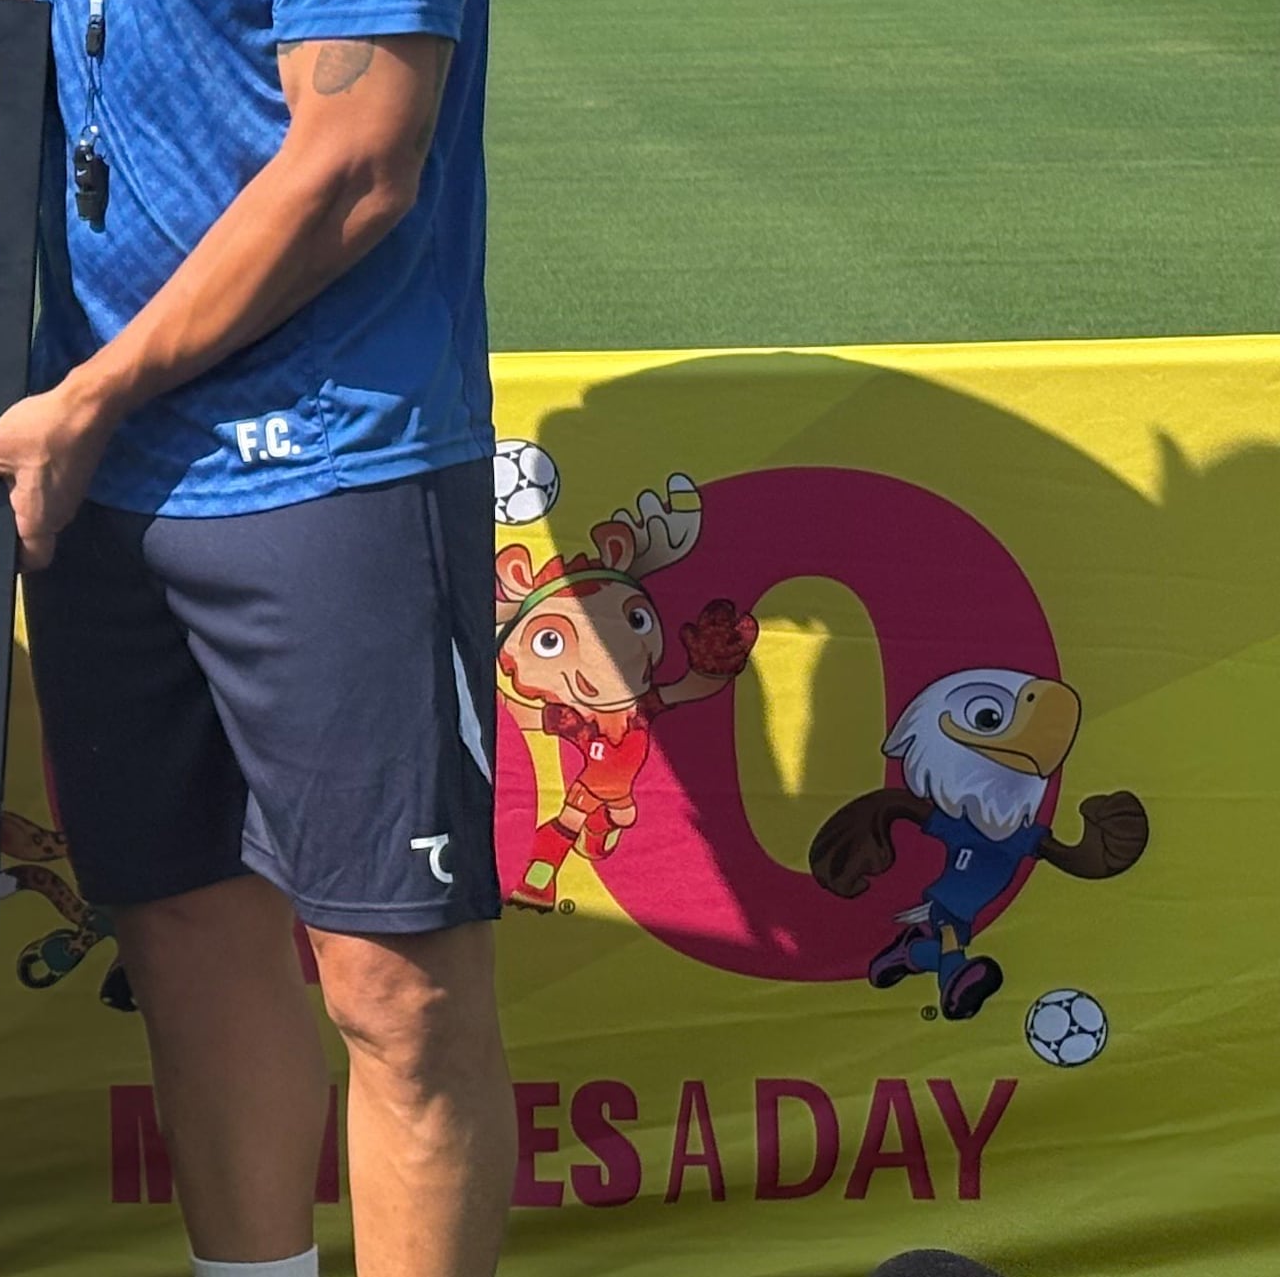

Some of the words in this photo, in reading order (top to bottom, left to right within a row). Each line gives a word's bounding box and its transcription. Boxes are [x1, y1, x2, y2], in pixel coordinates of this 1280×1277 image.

[236, 417, 301, 463] F.C.
[664, 1080, 726, 1204] A
[755, 1078, 1018, 1200] DAY
